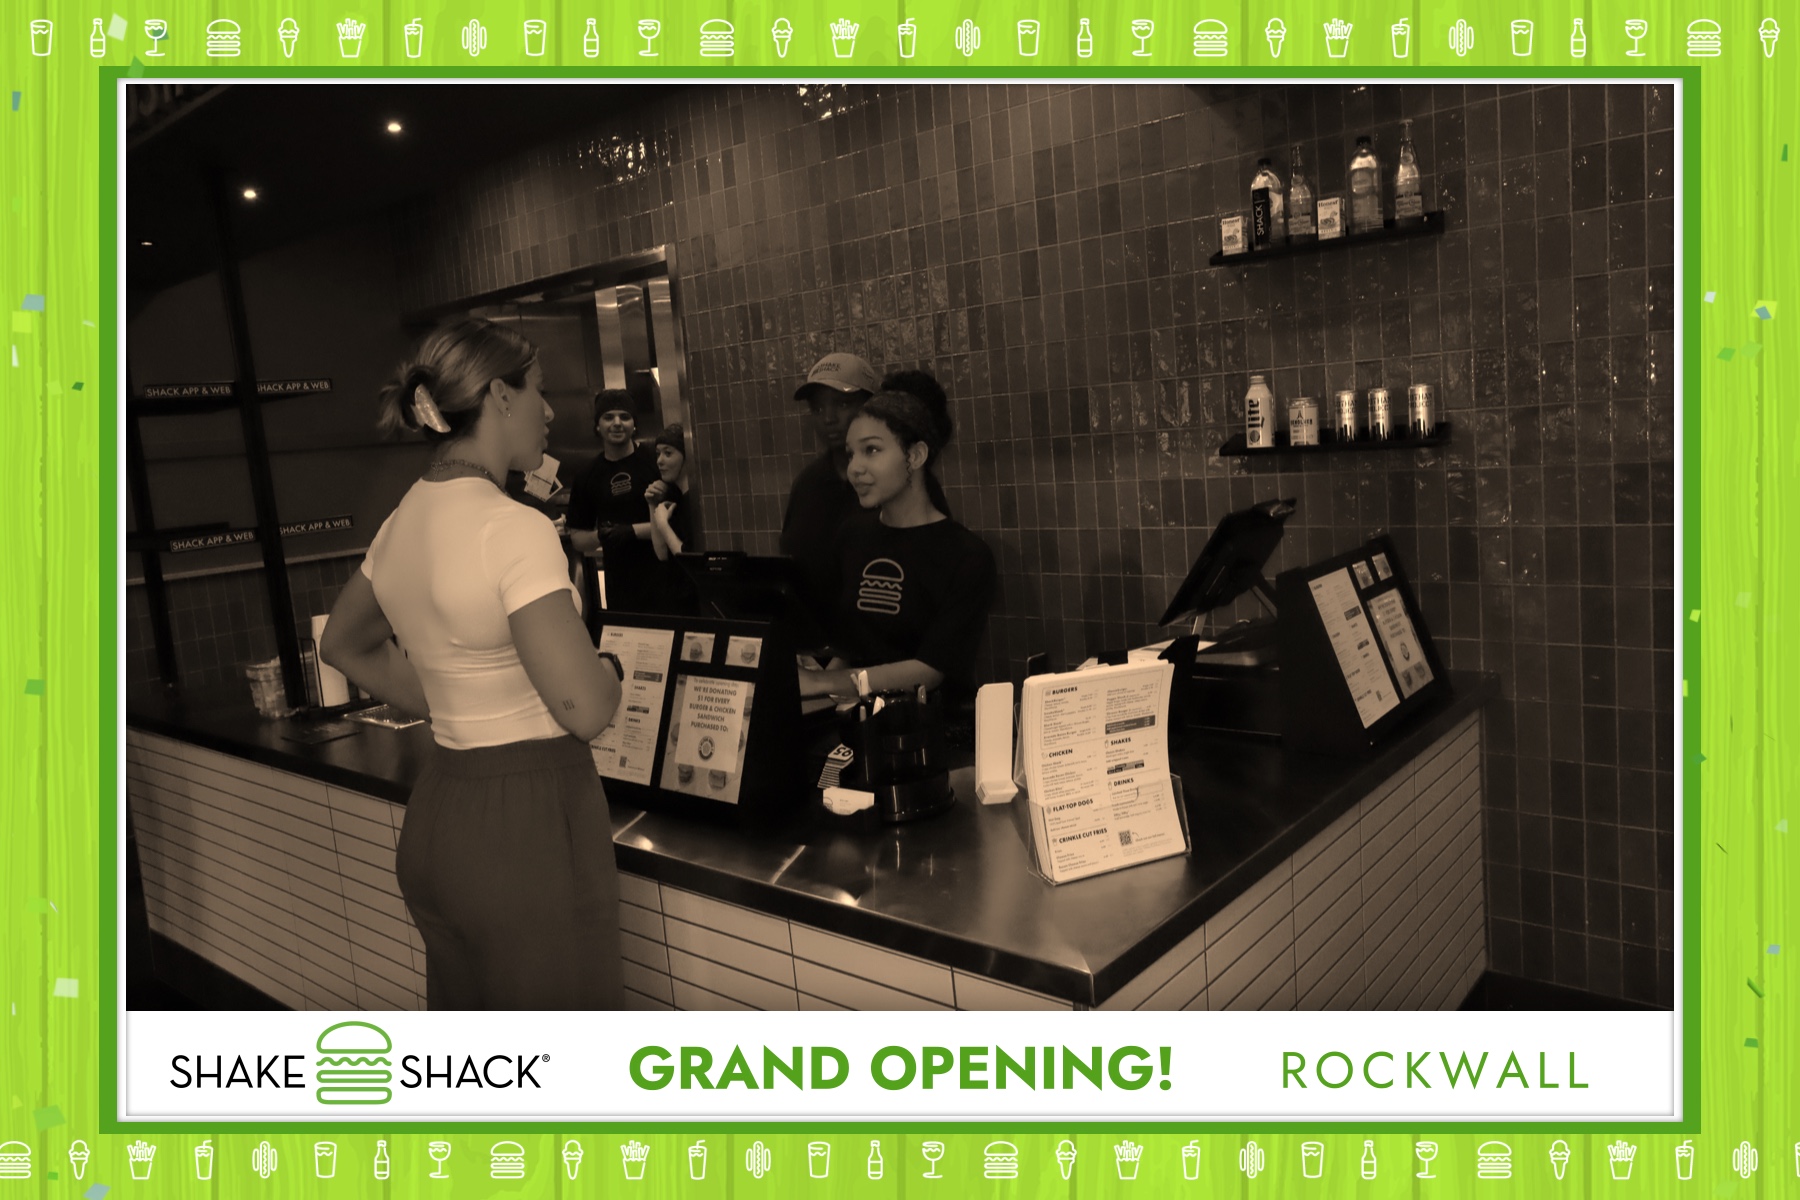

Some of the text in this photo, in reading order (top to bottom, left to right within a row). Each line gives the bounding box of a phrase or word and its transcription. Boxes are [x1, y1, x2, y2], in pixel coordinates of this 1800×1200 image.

[1256, 204, 1265, 236] SHACK
[286, 382, 301, 391] APP
[303, 382, 309, 390] &
[310, 381, 329, 389] WEB
[147, 386, 231, 397] SHACK APP & WEB
[308, 522, 323, 531] APP
[325, 521, 331, 529] &
[332, 518, 350, 528] WEB
[172, 532, 253, 550] SHACK APP & WEB
[709, 688, 737, 696] DONATING
[1052, 686, 1078, 695] BURGERS
[714, 706, 736, 715] CHICKEN
[697, 713, 725, 722] SANDWICH
[691, 721, 720, 730] PURCHASED
[1110, 737, 1131, 746] SHAKES
[1049, 749, 1073, 758] CHICKEN
[1114, 778, 1134, 787] DRINKS
[1078, 798, 1094, 807] DOGS
[1059, 828, 1108, 844] CRINKLE CUT FRIES
